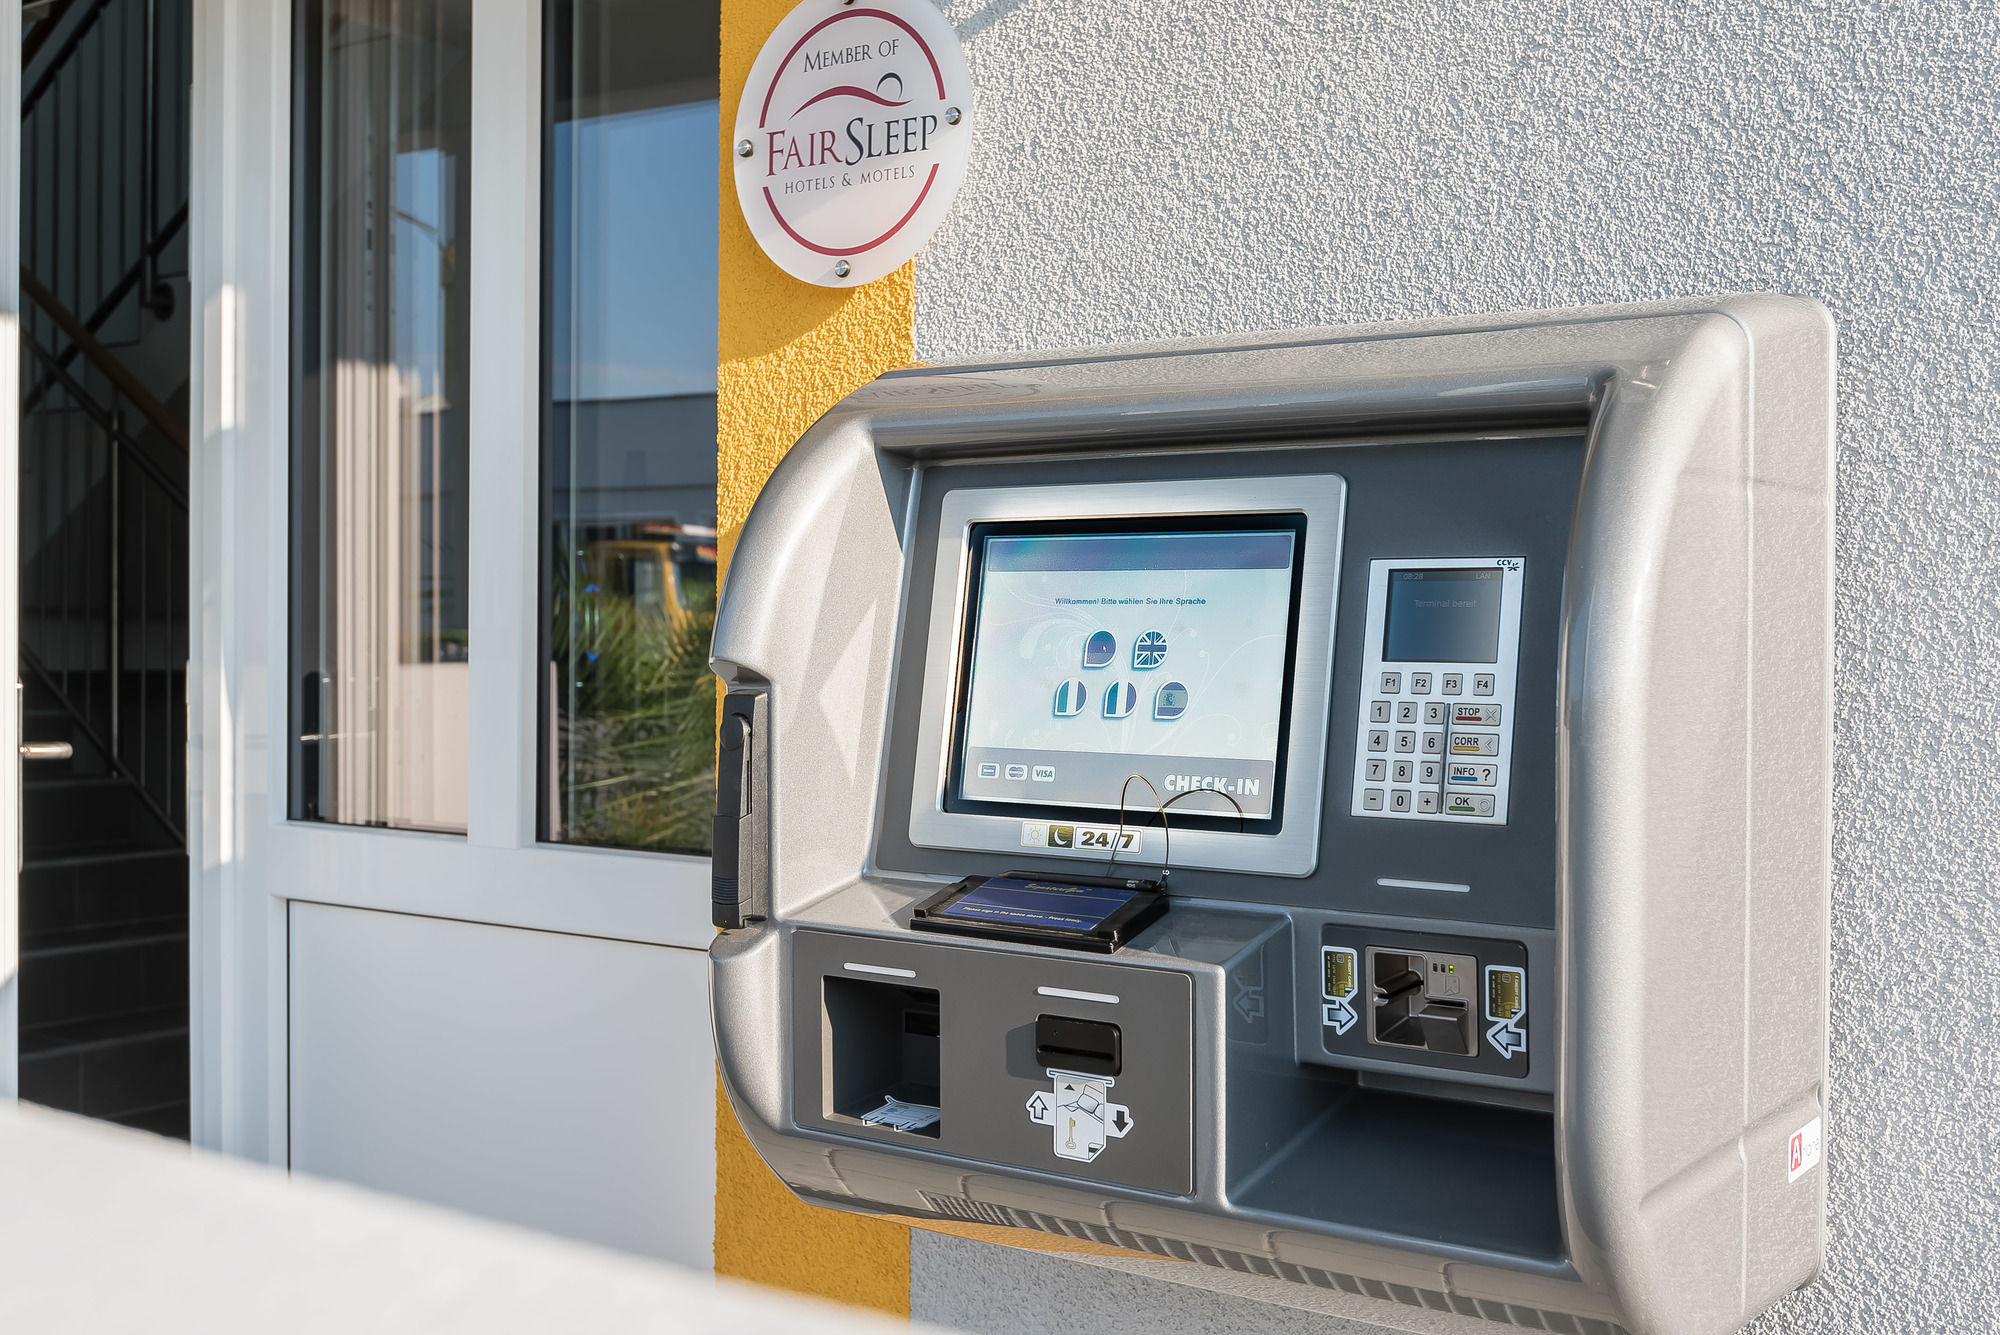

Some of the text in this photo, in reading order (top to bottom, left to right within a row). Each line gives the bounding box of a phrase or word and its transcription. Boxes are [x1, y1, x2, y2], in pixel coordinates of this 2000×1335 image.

[803, 39, 900, 72] MEMBER OF
[785, 165, 915, 194] HOTELS & MOTELS
[1475, 572, 1491, 580] LAN
[1055, 597, 1099, 605] Willkommen!
[1100, 597, 1117, 605] Bitte
[1175, 598, 1207, 607] Sprache
[1415, 599, 1450, 608] Terminal
[1385, 678, 1396, 687] F1
[1415, 678, 1427, 688] F2
[1446, 679, 1457, 689] F3
[1477, 680, 1489, 689] F4
[1377, 707, 1383, 717] 1
[1403, 707, 1410, 718] 2
[1430, 708, 1437, 718] 3
[1457, 707, 1480, 716] STOP
[1373, 736, 1381, 746] 4
[1401, 737, 1408, 747] 5
[1428, 738, 1435, 748] 6
[1454, 736, 1479, 746] CORR
[1035, 769, 1053, 778] VISA
[1372, 765, 1379, 775] 7
[1398, 766, 1405, 776] 8
[1426, 767, 1433, 777] 9
[1453, 767, 1491, 781] INFO ?
[1164, 774, 1260, 796] CHECK-IN
[1396, 796, 1404, 806] 0
[1454, 797, 1470, 806] OK
[1081, 831, 1134, 849] 24/7
